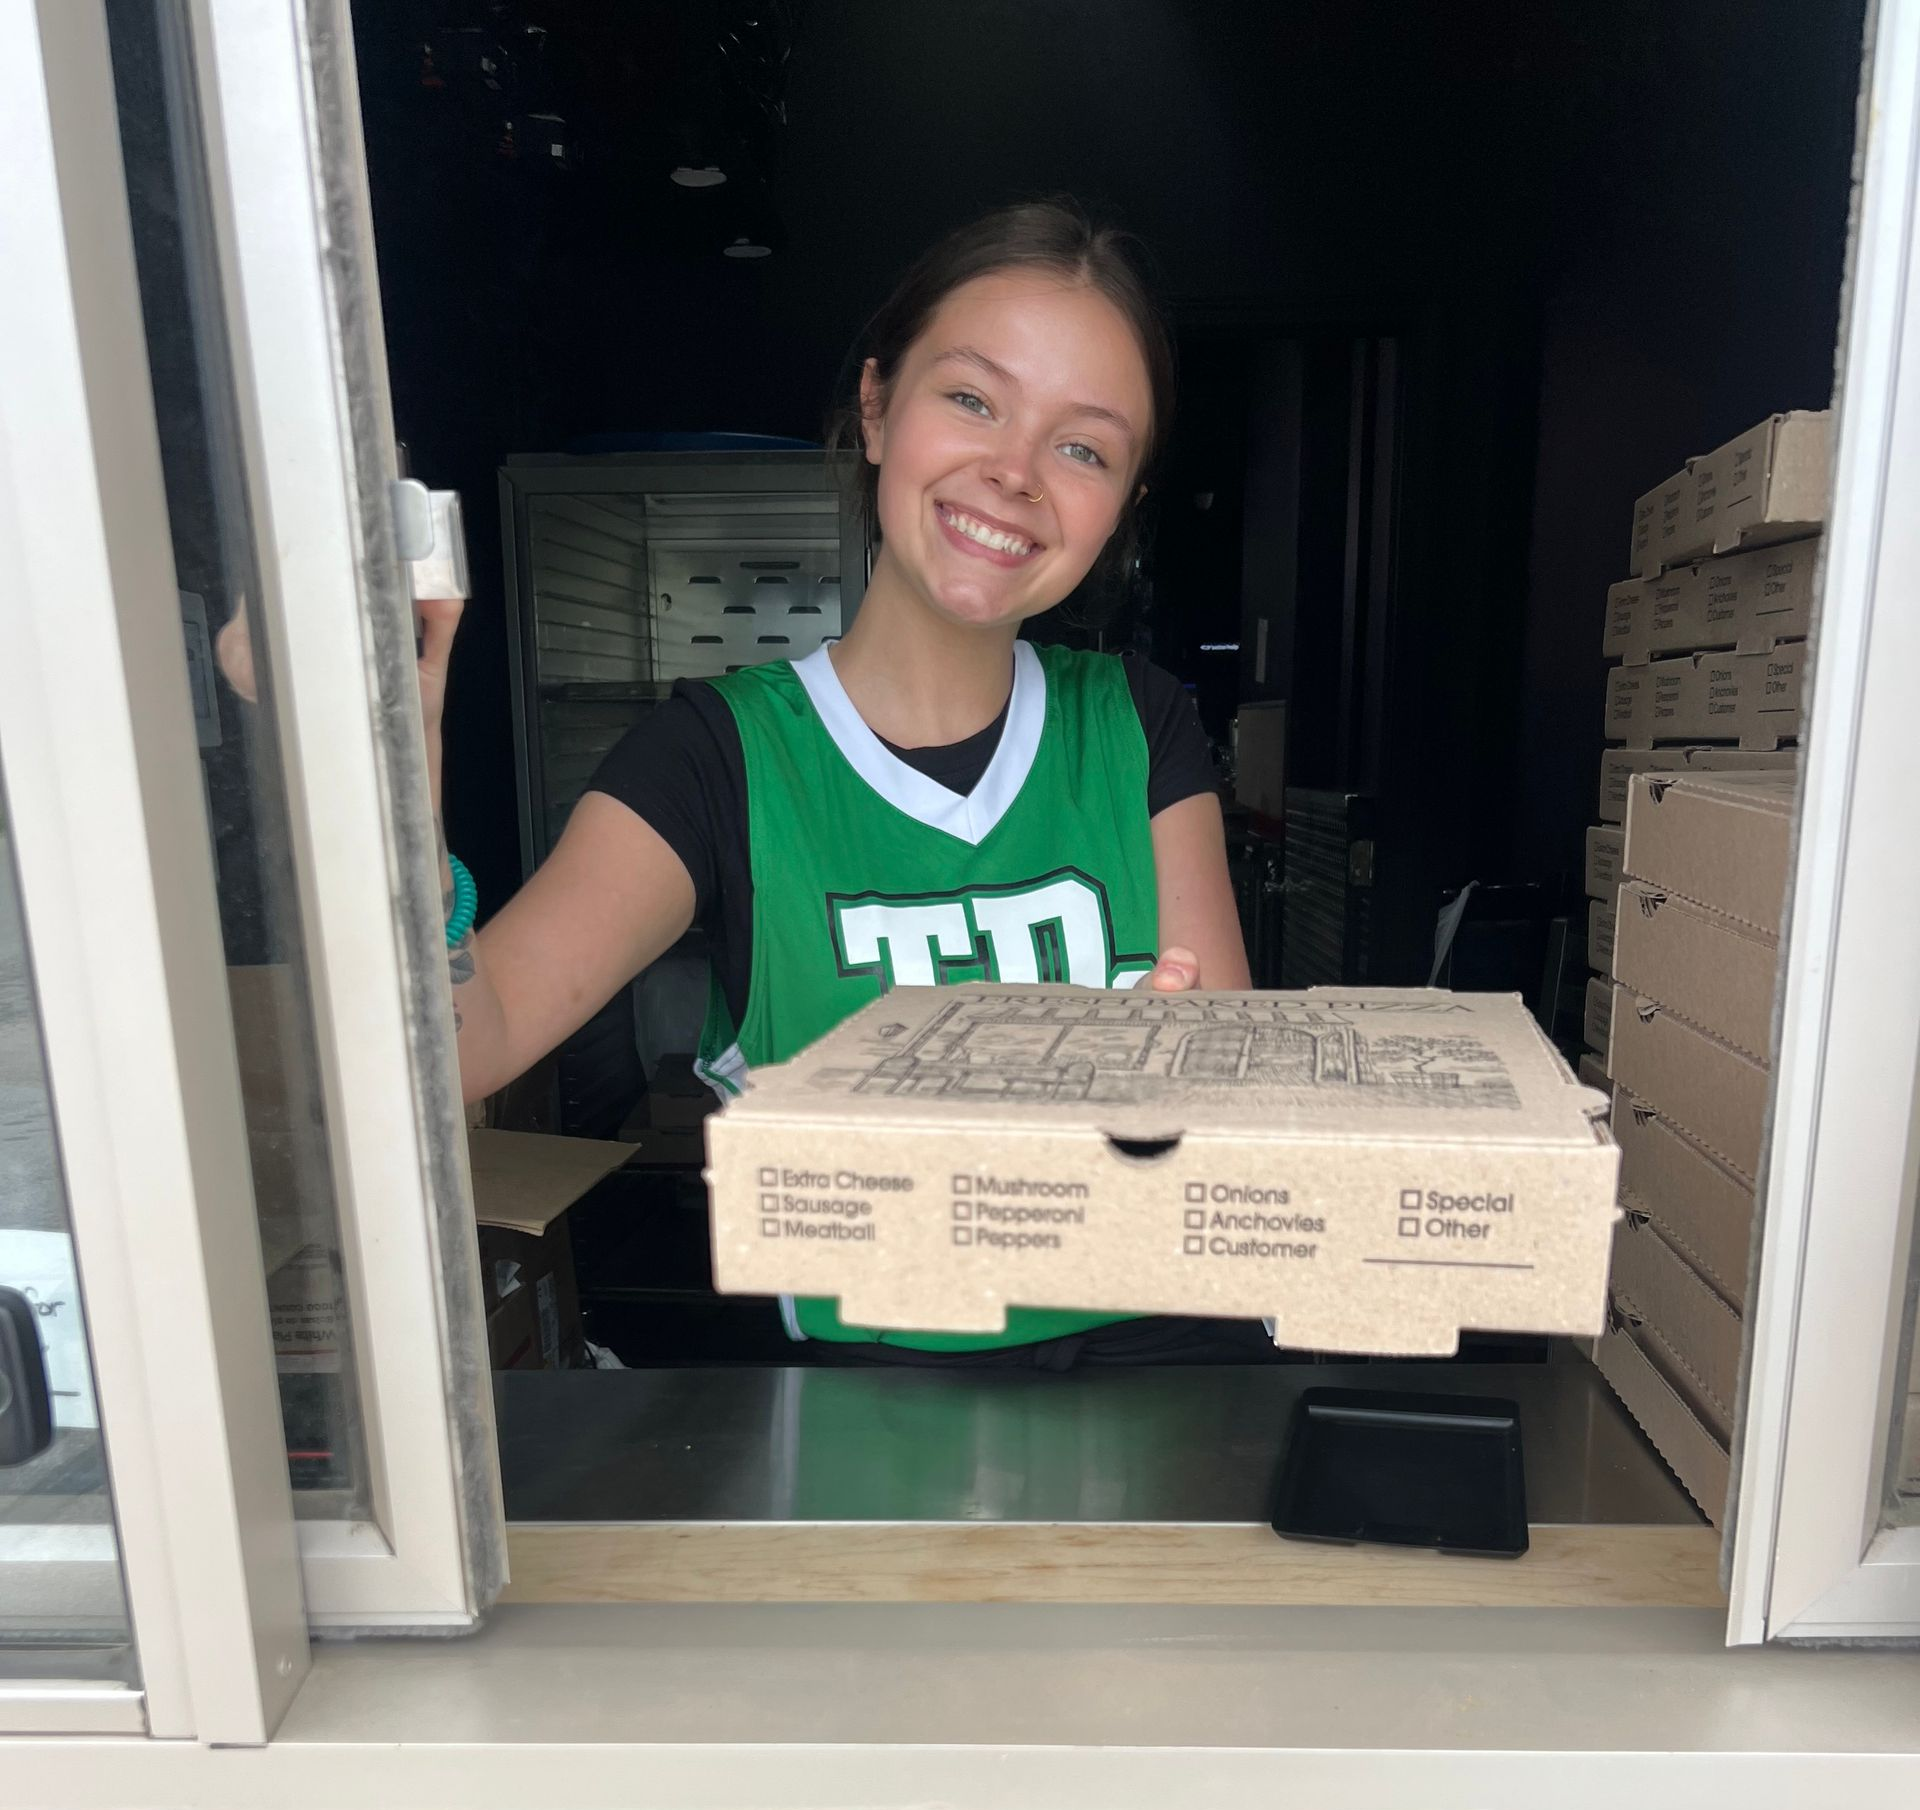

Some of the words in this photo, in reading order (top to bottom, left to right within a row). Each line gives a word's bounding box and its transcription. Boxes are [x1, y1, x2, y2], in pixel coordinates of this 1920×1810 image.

[782, 1169, 831, 1189] Extra
[835, 1170, 915, 1192] Cheese
[976, 1176, 1089, 1198] Mushroom
[1210, 1183, 1290, 1204] Onions
[1426, 1190, 1514, 1213] Special
[783, 1194, 873, 1219] Sausage
[976, 1201, 1086, 1225] Pepperoni
[784, 1219, 876, 1241] Meatball
[1209, 1210, 1326, 1232] Anchovies
[1425, 1217, 1490, 1239] Other
[976, 1227, 1062, 1251] Peppers
[1208, 1236, 1317, 1258] Customer
